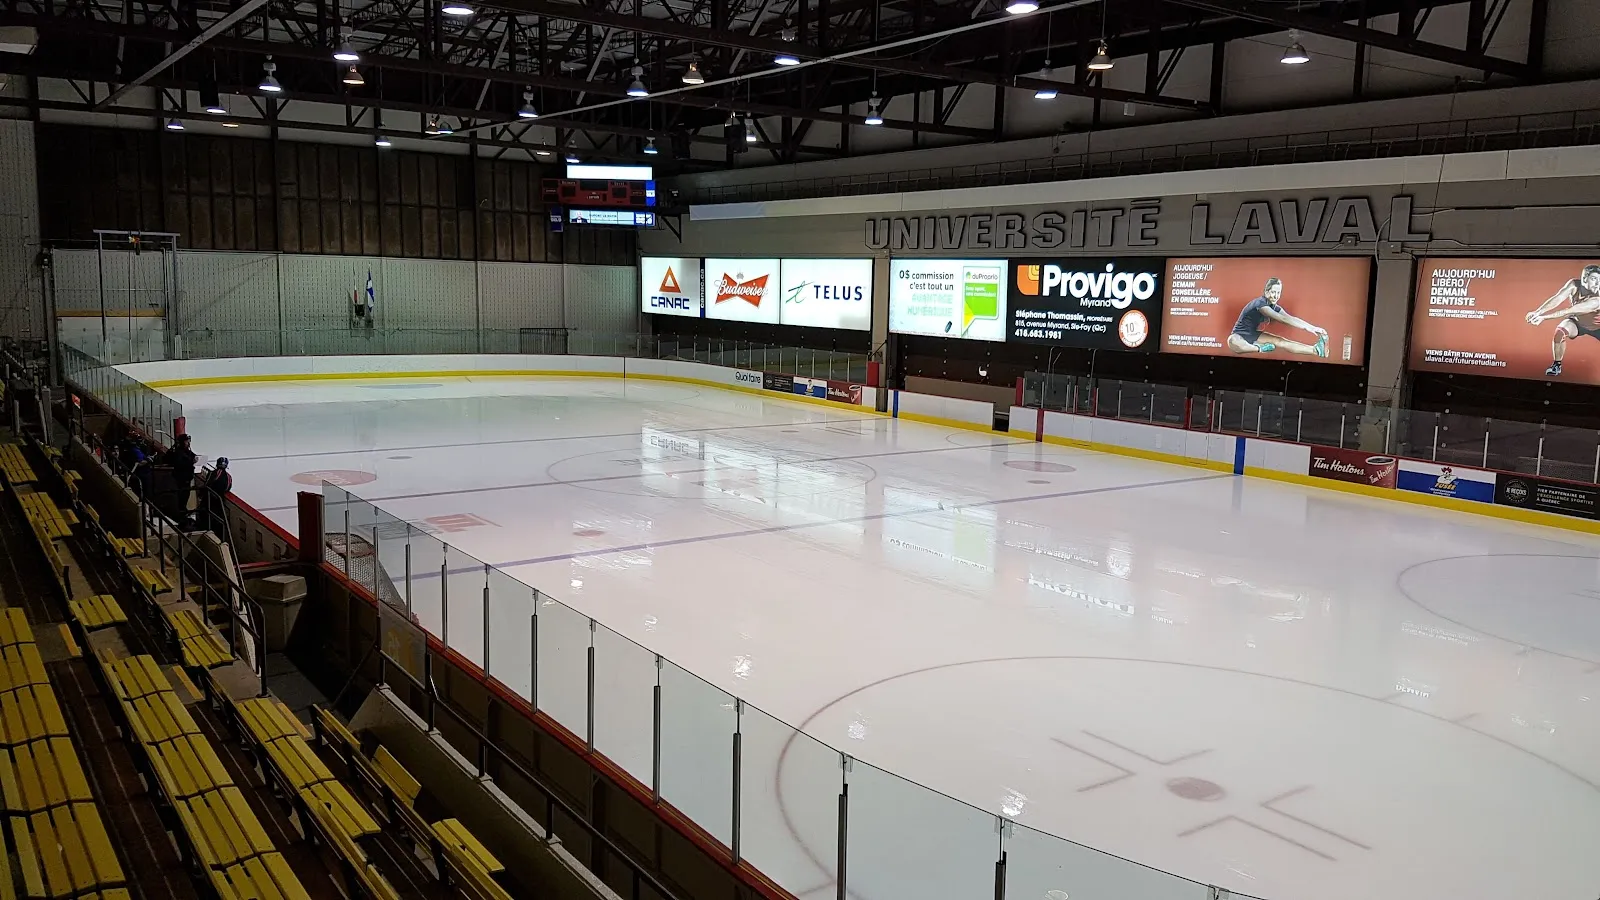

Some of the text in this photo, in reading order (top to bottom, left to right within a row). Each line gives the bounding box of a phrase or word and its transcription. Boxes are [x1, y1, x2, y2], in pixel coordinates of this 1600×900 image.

[864, 196, 1432, 250] UNIVERSITÉ LAVAL
[899, 269, 954, 280] 0$ commission
[972, 273, 998, 281] duProprio
[1432, 269, 1495, 278] AUJOURD'HUI
[909, 281, 954, 291] c'est tout un
[1042, 262, 1155, 309] Provigo
[1431, 276, 1465, 288] LIBÉRO
[714, 279, 769, 298] Budweiser
[813, 284, 863, 301] TELUS
[1171, 288, 1211, 296] CONSEILLÈRE
[1430, 287, 1468, 297] DEMAIN
[650, 296, 690, 310] CANAC
[911, 292, 953, 305] AVANTAGE
[1080, 298, 1111, 308] Myrand
[1180, 296, 1219, 304] ORIENTATION
[1430, 297, 1475, 306] DENTISTE
[1015, 310, 1046, 319] Stéphane
[1047, 311, 1085, 322] Thomassin,
[1025, 321, 1046, 329] avenue
[1070, 323, 1091, 332] Ste-Foy
[1092, 324, 1107, 333] (Qc)
[1014, 328, 1062, 339] 418.683.1981
[1443, 349, 1460, 357] BÂTIR
[1313, 457, 1365, 476] Tim Hortons
[1548, 490, 1578, 499] PARTENAIRE
[1571, 497, 1594, 506] SPORTIVE
